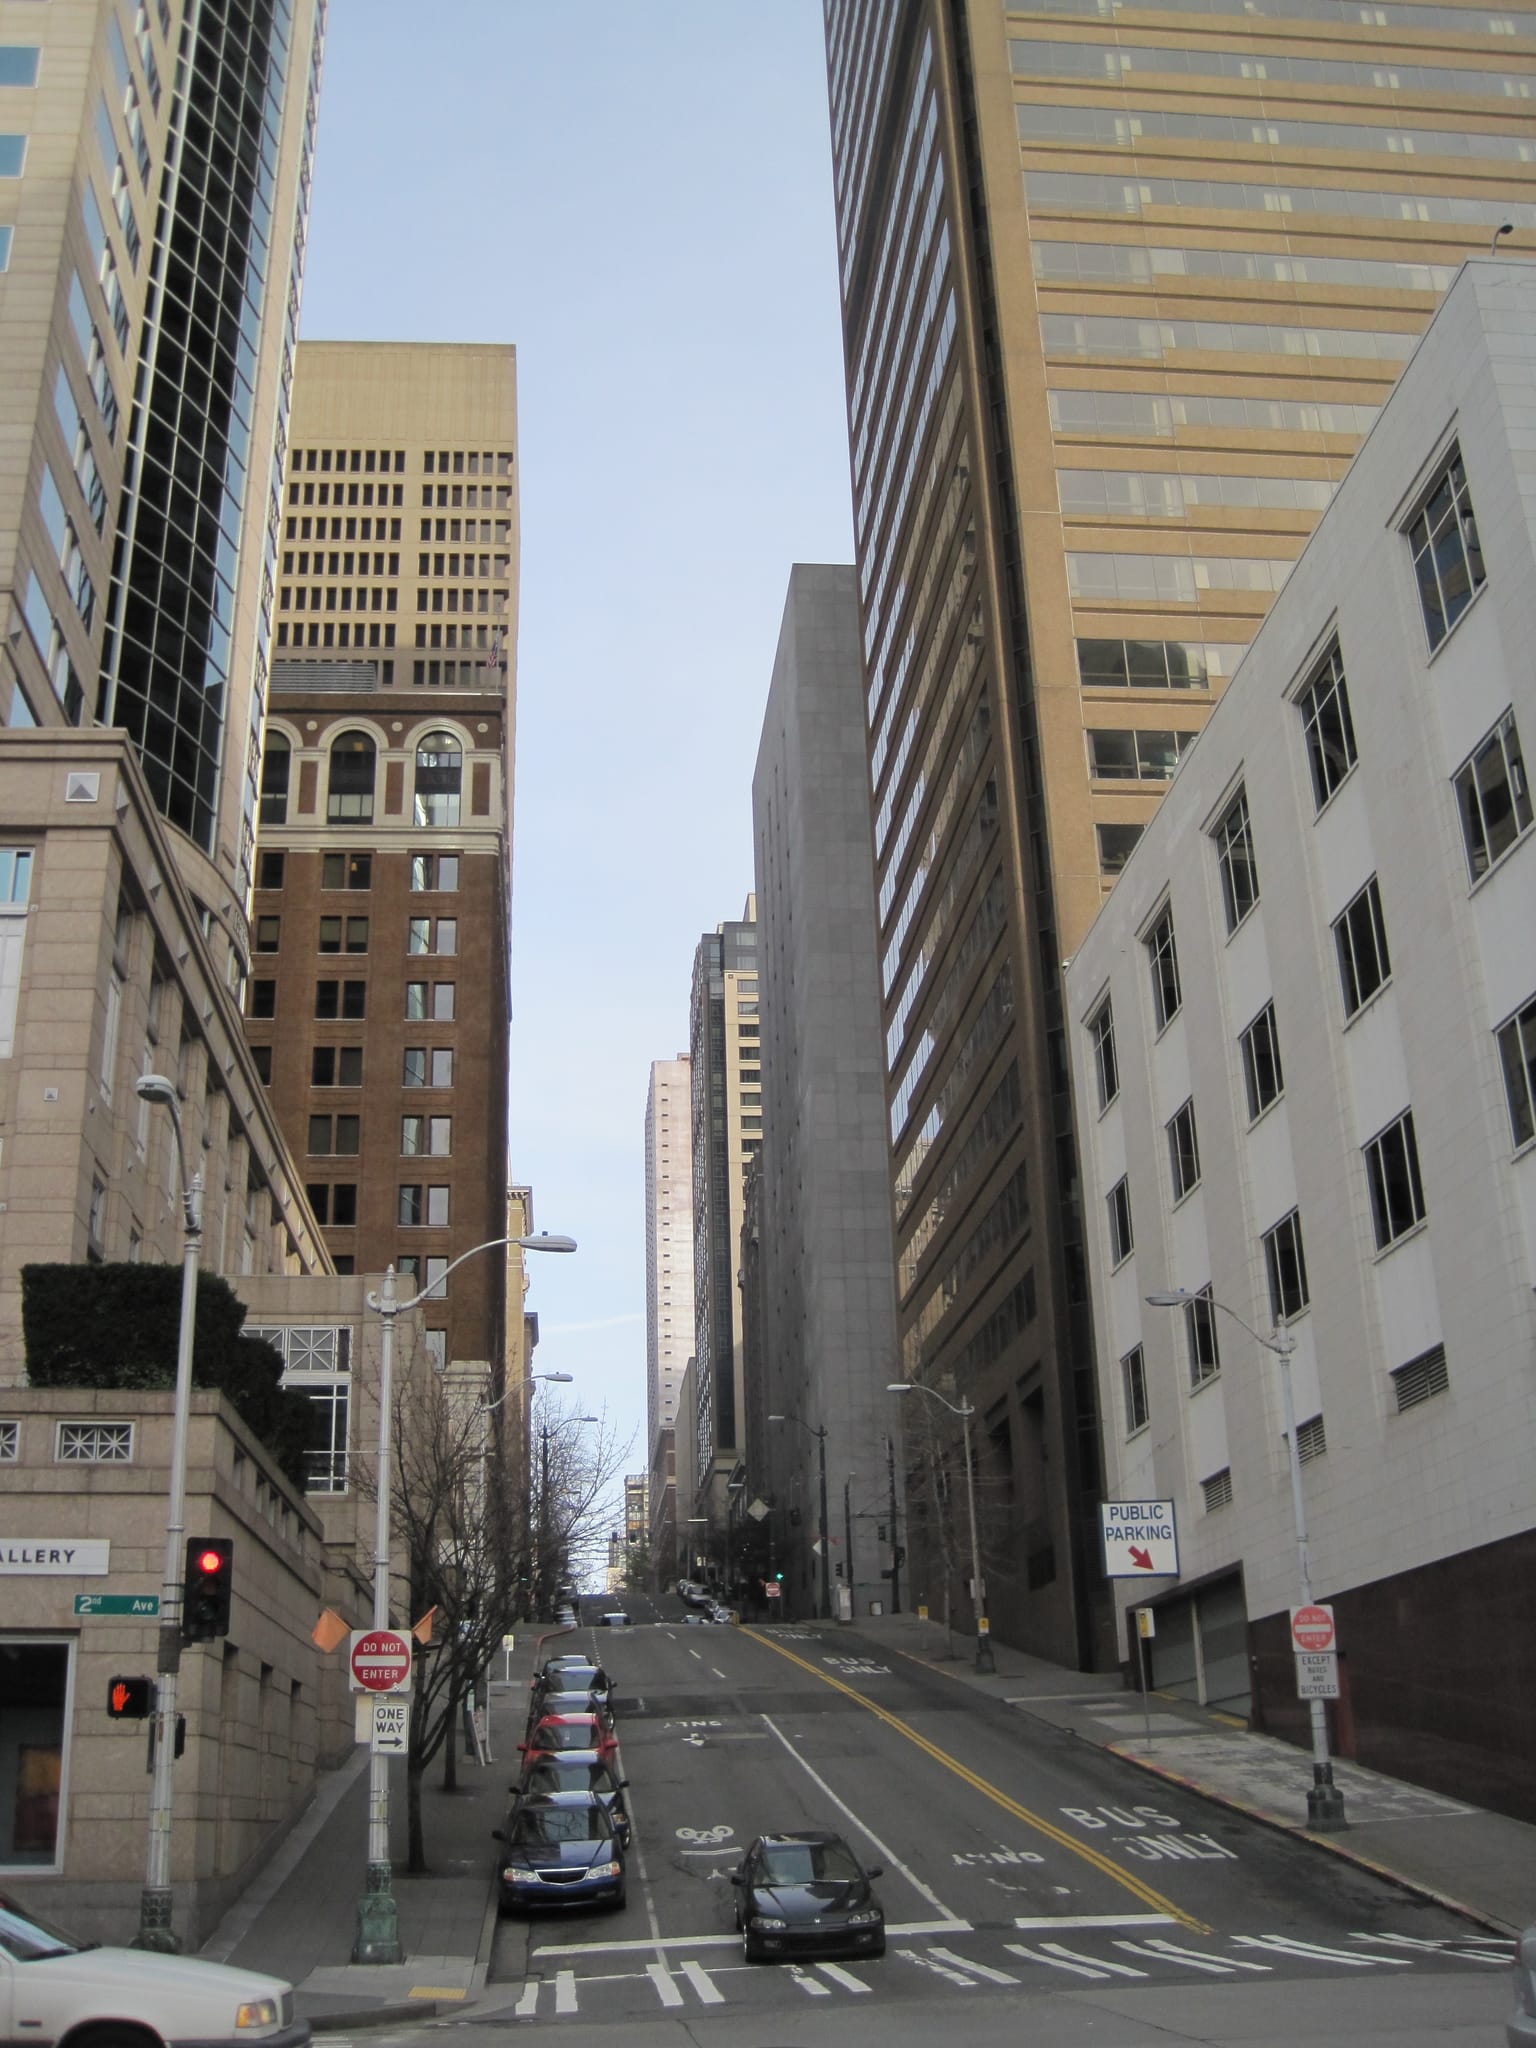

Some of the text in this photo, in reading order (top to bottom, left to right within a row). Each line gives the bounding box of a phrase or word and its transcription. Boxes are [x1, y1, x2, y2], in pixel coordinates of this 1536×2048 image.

[1110, 1505, 1164, 1520] PUBLIC
[1105, 1525, 1172, 1541] PARKING
[79, 1596, 153, 1612] 2nd Ave
[1299, 1614, 1326, 1623] DO NOT
[1301, 1634, 1326, 1642] ENTER
[363, 1642, 401, 1652] DO NOT
[822, 1657, 875, 1665] BUS
[1302, 1656, 1330, 1665] EXCEPT
[362, 1669, 399, 1679] ENTER
[840, 1665, 892, 1674] ONLY
[1301, 1684, 1336, 1695] BICYCLES
[376, 1708, 404, 1720] ONE
[376, 1722, 405, 1733] WAY
[1059, 1805, 1181, 1829] BUS
[1112, 1833, 1240, 1861] ONLY
